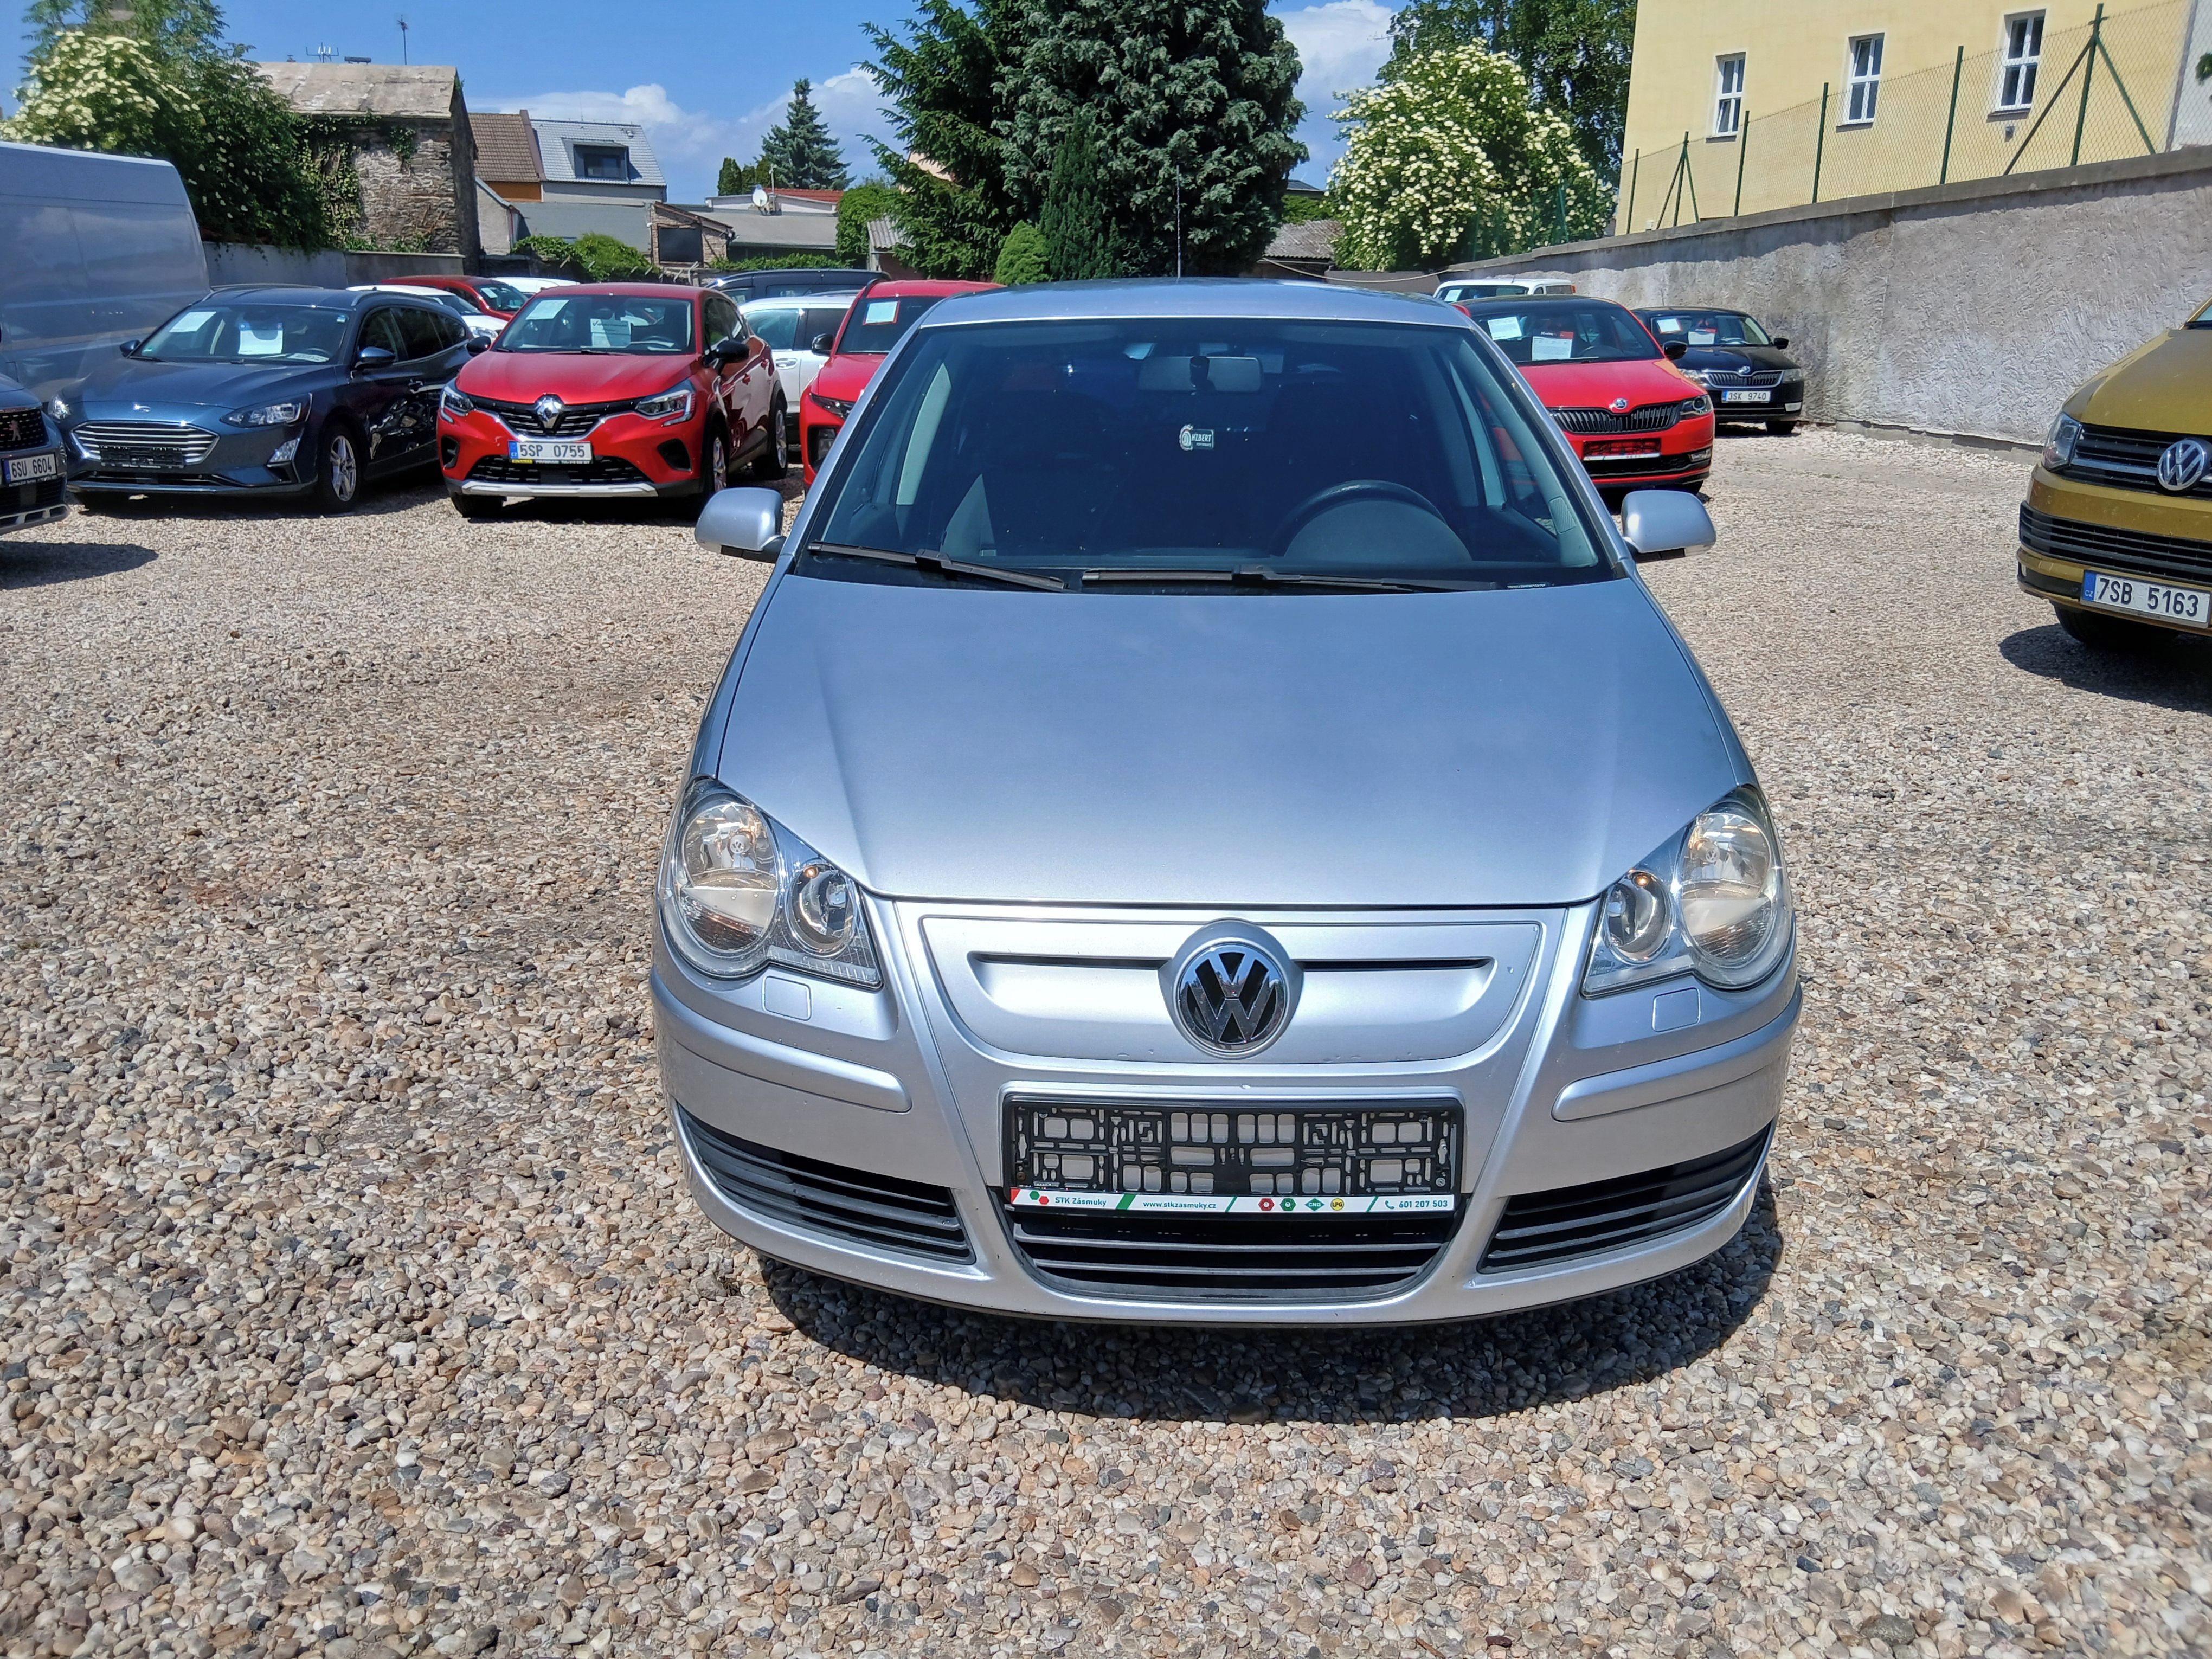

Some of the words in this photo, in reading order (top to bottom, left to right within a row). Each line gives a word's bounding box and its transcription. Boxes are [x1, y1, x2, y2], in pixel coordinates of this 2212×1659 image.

[520, 445, 543, 457] 5SP
[554, 445, 585, 458] 0755
[11, 460, 27, 478] 6SU
[32, 456, 52, 474] 6604
[2085, 589, 2093, 597] CZ
[2098, 577, 2133, 605] 7SB
[2147, 587, 2199, 617] 5163
[1072, 1197, 1107, 1207] Zásmuky
[1143, 1201, 1217, 1210] www.stkzasmuky.cz
[1433, 1200, 1448, 1208] 503
